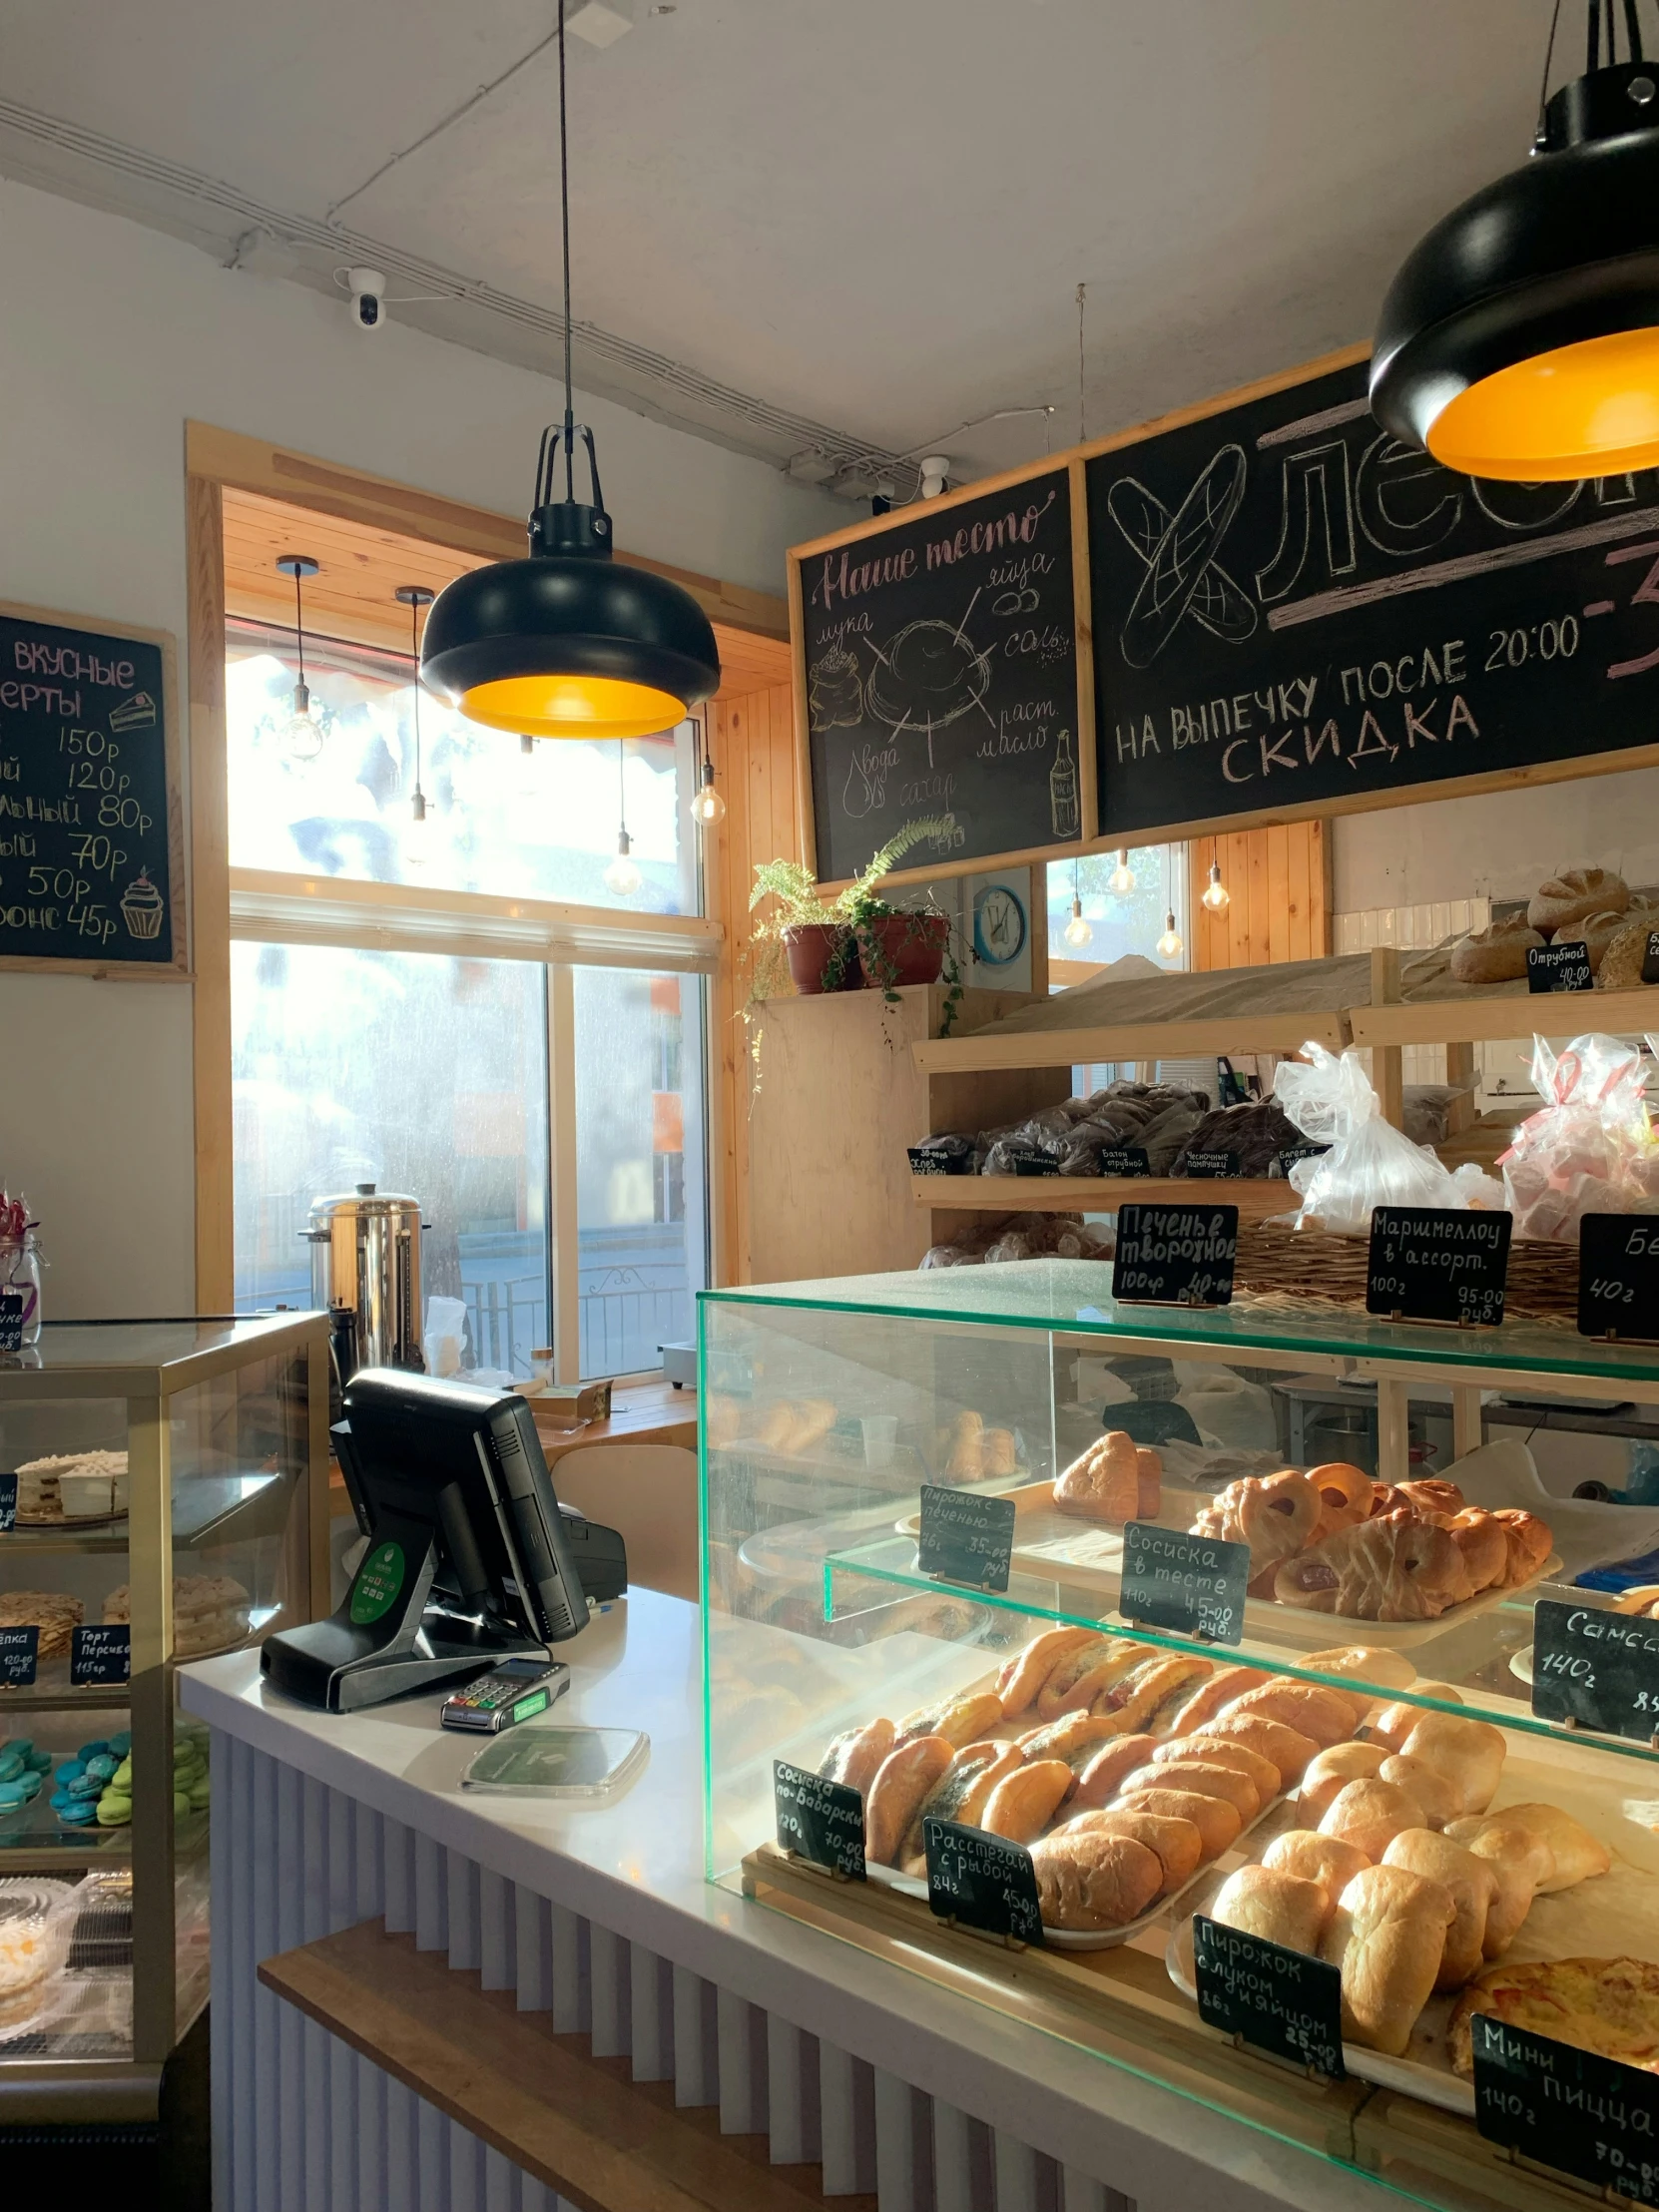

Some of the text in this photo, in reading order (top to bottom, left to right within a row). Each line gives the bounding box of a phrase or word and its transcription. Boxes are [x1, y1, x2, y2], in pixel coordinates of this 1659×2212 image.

[812, 489, 1056, 611] Наше тесто
[985, 552, 1056, 590] яйца
[817, 612, 873, 654] мука
[1004, 625, 1060, 659] соль
[1115, 615, 1579, 765] НА ВЫПЕЧКУ ПОСЛЕ 20:00
[59, 727, 120, 764] 150р
[977, 725, 1049, 759] масло
[1222, 694, 1480, 784] СКИДКА
[69, 762, 131, 796] 120р
[861, 743, 901, 784] вода
[899, 773, 958, 812] сахар
[98, 795, 153, 837] 80р
[68, 832, 128, 882] 70р
[27, 866, 91, 904] 50р
[67, 904, 118, 945] 45р
[1529, 945, 1586, 967] Отрубной
[1560, 966, 1591, 984] 40-00
[1101, 1148, 1129, 1158] Батон
[1106, 1158, 1144, 1170] отрубной
[1186, 1151, 1229, 1162] Чесночные
[1122, 1206, 1226, 1239] Печенье
[1374, 1211, 1501, 1252] Маршмеллоу
[1383, 1243, 1488, 1283] в ассорт.
[1371, 1276, 1407, 1296] 100г
[1457, 1286, 1504, 1306] 95-00
[1589, 1278, 1636, 1304] 40г
[923, 1486, 982, 1510] Пирожок
[924, 1506, 988, 1529] печенью
[1129, 1526, 1219, 1568] Сосиска
[1134, 1555, 1228, 1596] в тесте
[1184, 1592, 1234, 1622] 45-00
[81, 1630, 110, 1646] Торт
[1541, 1652, 1597, 1689] 140г
[930, 1824, 1029, 1874] Расстегай
[940, 1853, 950, 1866] с
[1201, 1922, 1302, 1983] Пирожок
[1210, 1961, 1275, 1997] луком
[1239, 1988, 1327, 2040] и яйцом
[1484, 2022, 1555, 2073] Мини
[1481, 2086, 1537, 2126] 140г
